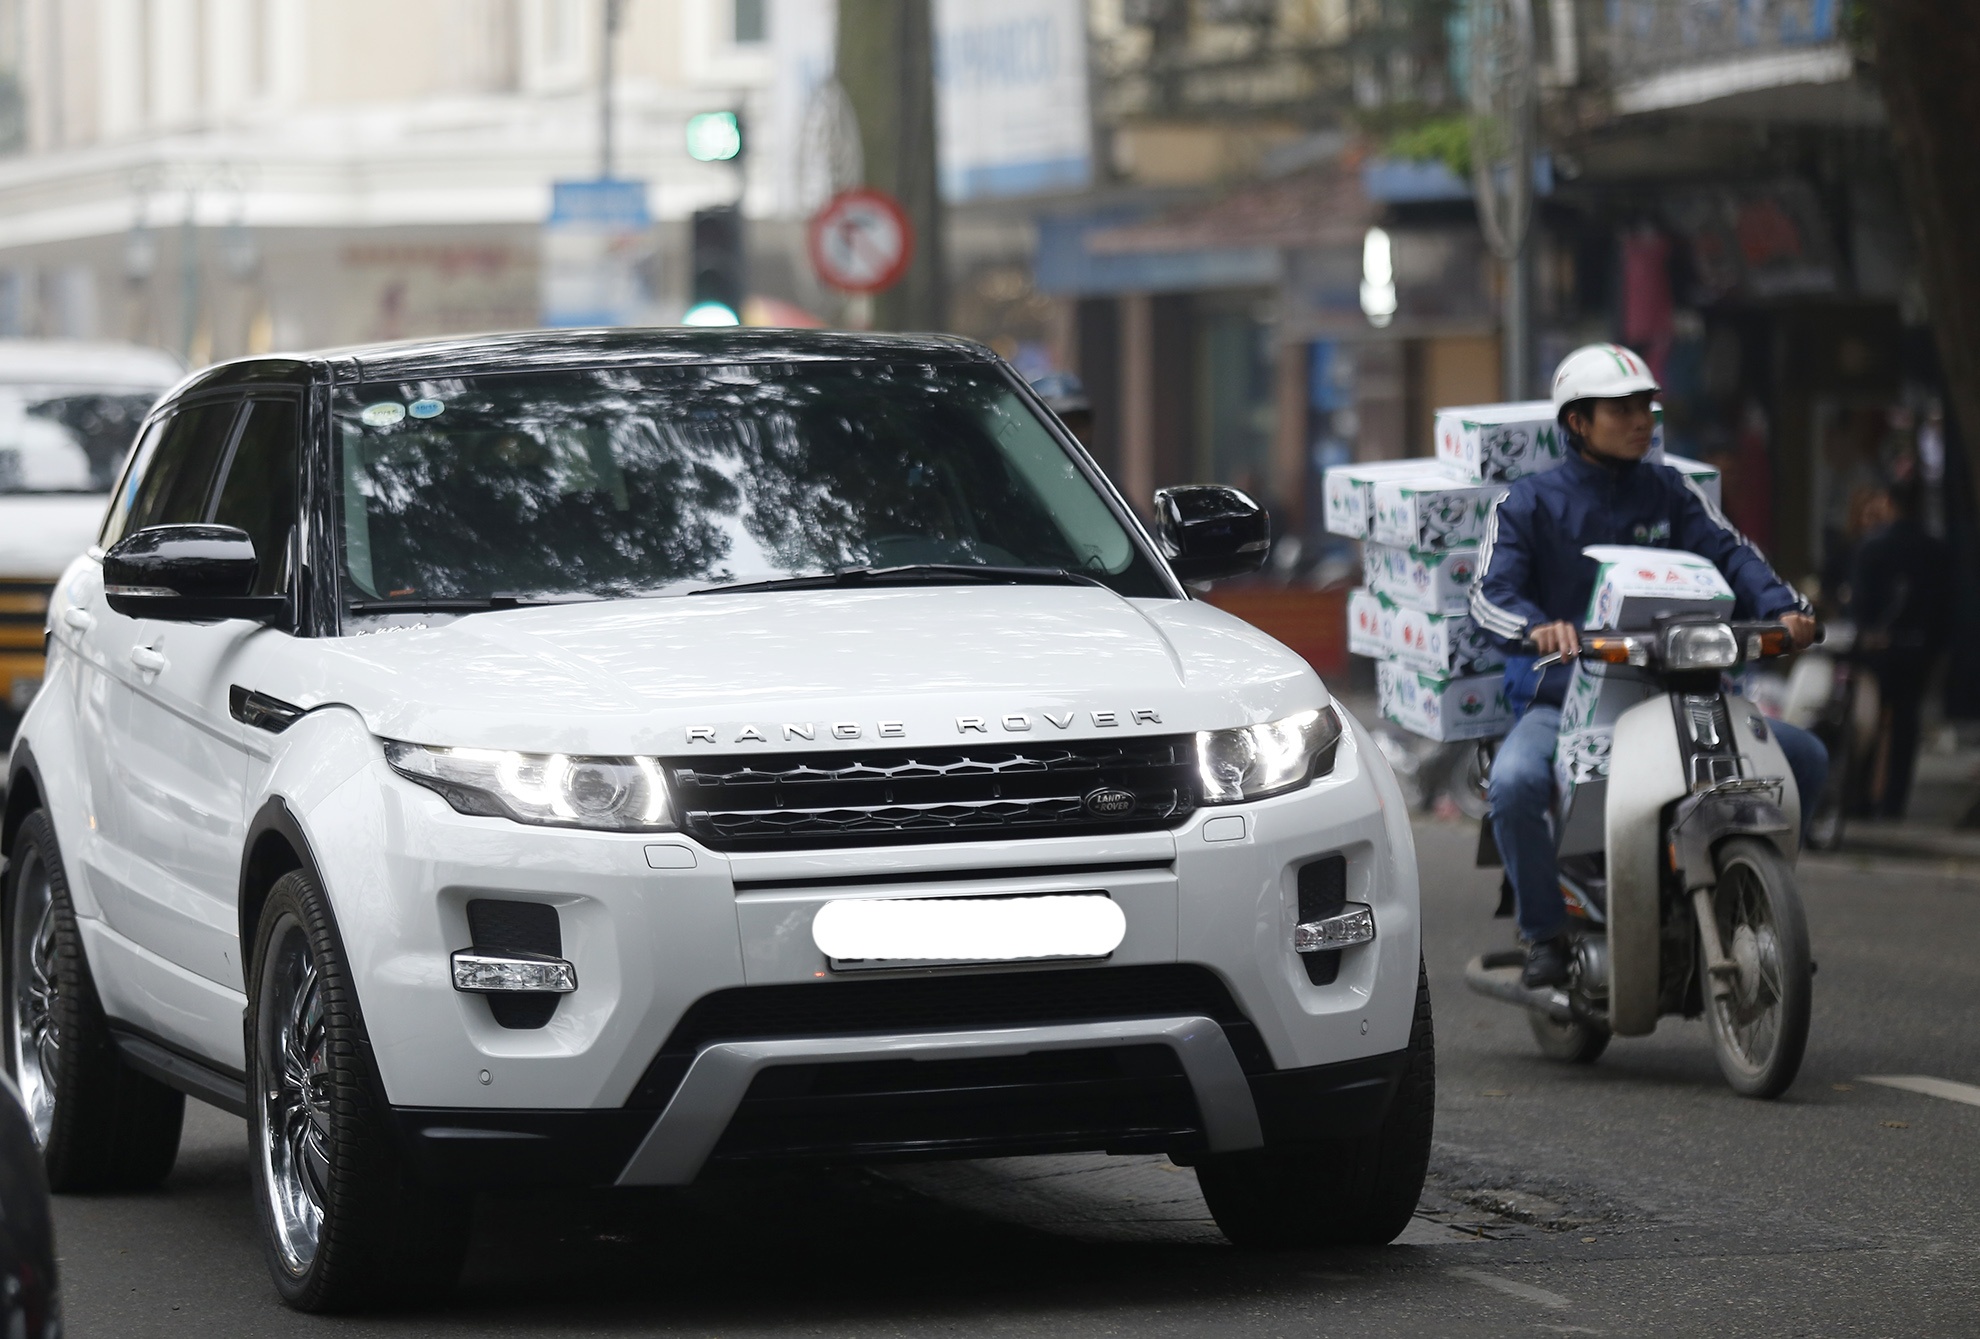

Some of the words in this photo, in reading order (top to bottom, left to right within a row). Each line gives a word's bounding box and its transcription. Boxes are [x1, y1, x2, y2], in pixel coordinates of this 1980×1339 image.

[685, 719, 906, 744] RANGE
[955, 707, 1163, 734] ROVER
[1097, 794, 1121, 803] LAND
[1101, 801, 1129, 811] ROVER
